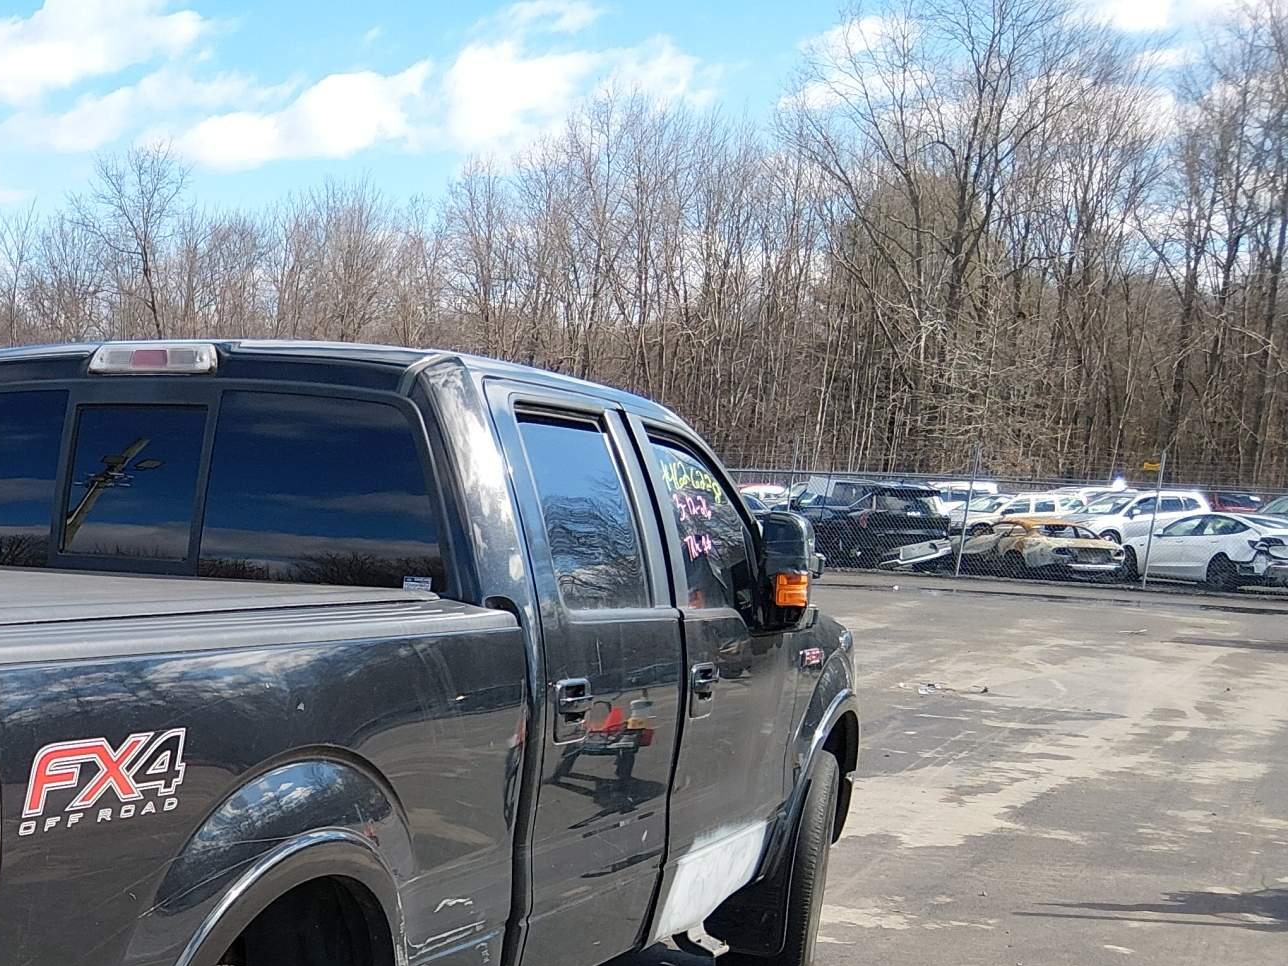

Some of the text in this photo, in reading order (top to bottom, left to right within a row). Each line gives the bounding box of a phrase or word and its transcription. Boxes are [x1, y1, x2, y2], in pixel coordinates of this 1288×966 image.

[22, 727, 186, 819] FX4
[18, 797, 178, 836] OFF ROAD
